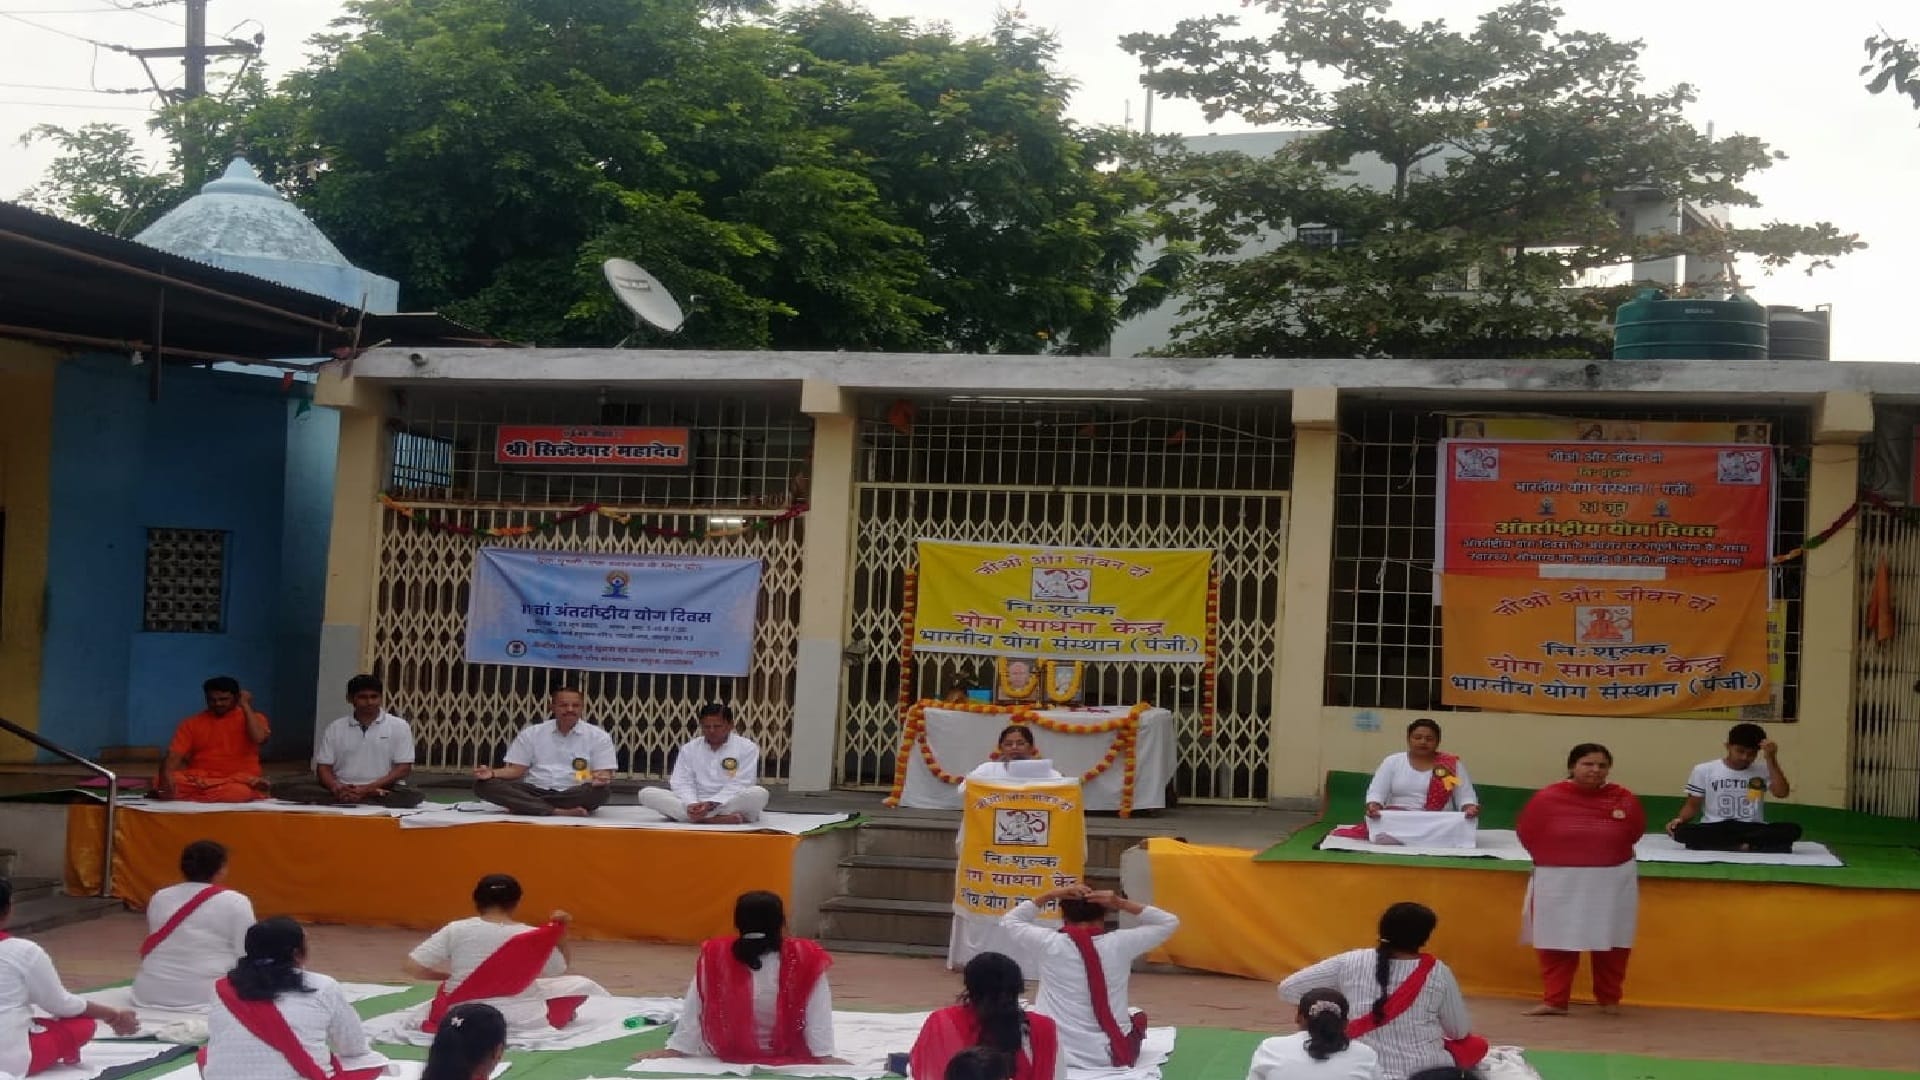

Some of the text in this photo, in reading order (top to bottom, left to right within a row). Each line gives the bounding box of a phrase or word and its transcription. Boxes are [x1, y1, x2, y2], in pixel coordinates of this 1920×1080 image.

[504, 440, 529, 457] श्री
[616, 441, 683, 458] महादेव
[1607, 520, 1651, 536] योग
[1658, 521, 1718, 537] दिवस
[1559, 586, 1606, 603] और
[1615, 586, 1682, 606] जीवन
[634, 606, 667, 623] योग
[670, 606, 712, 623] दिवस
[954, 611, 1166, 636] योग साधना केन्द्र
[920, 628, 993, 648] भारतीय
[1000, 632, 1041, 649] योग
[1051, 635, 1123, 652] संस्थान
[1488, 653, 1727, 679] योग साधना केन्द्र
[1451, 674, 1533, 696] भारतीय
[1540, 676, 1588, 699] योग
[1600, 681, 1680, 700] संस्थान
[992, 873, 1044, 887] साधना
[983, 890, 1008, 909] योग
